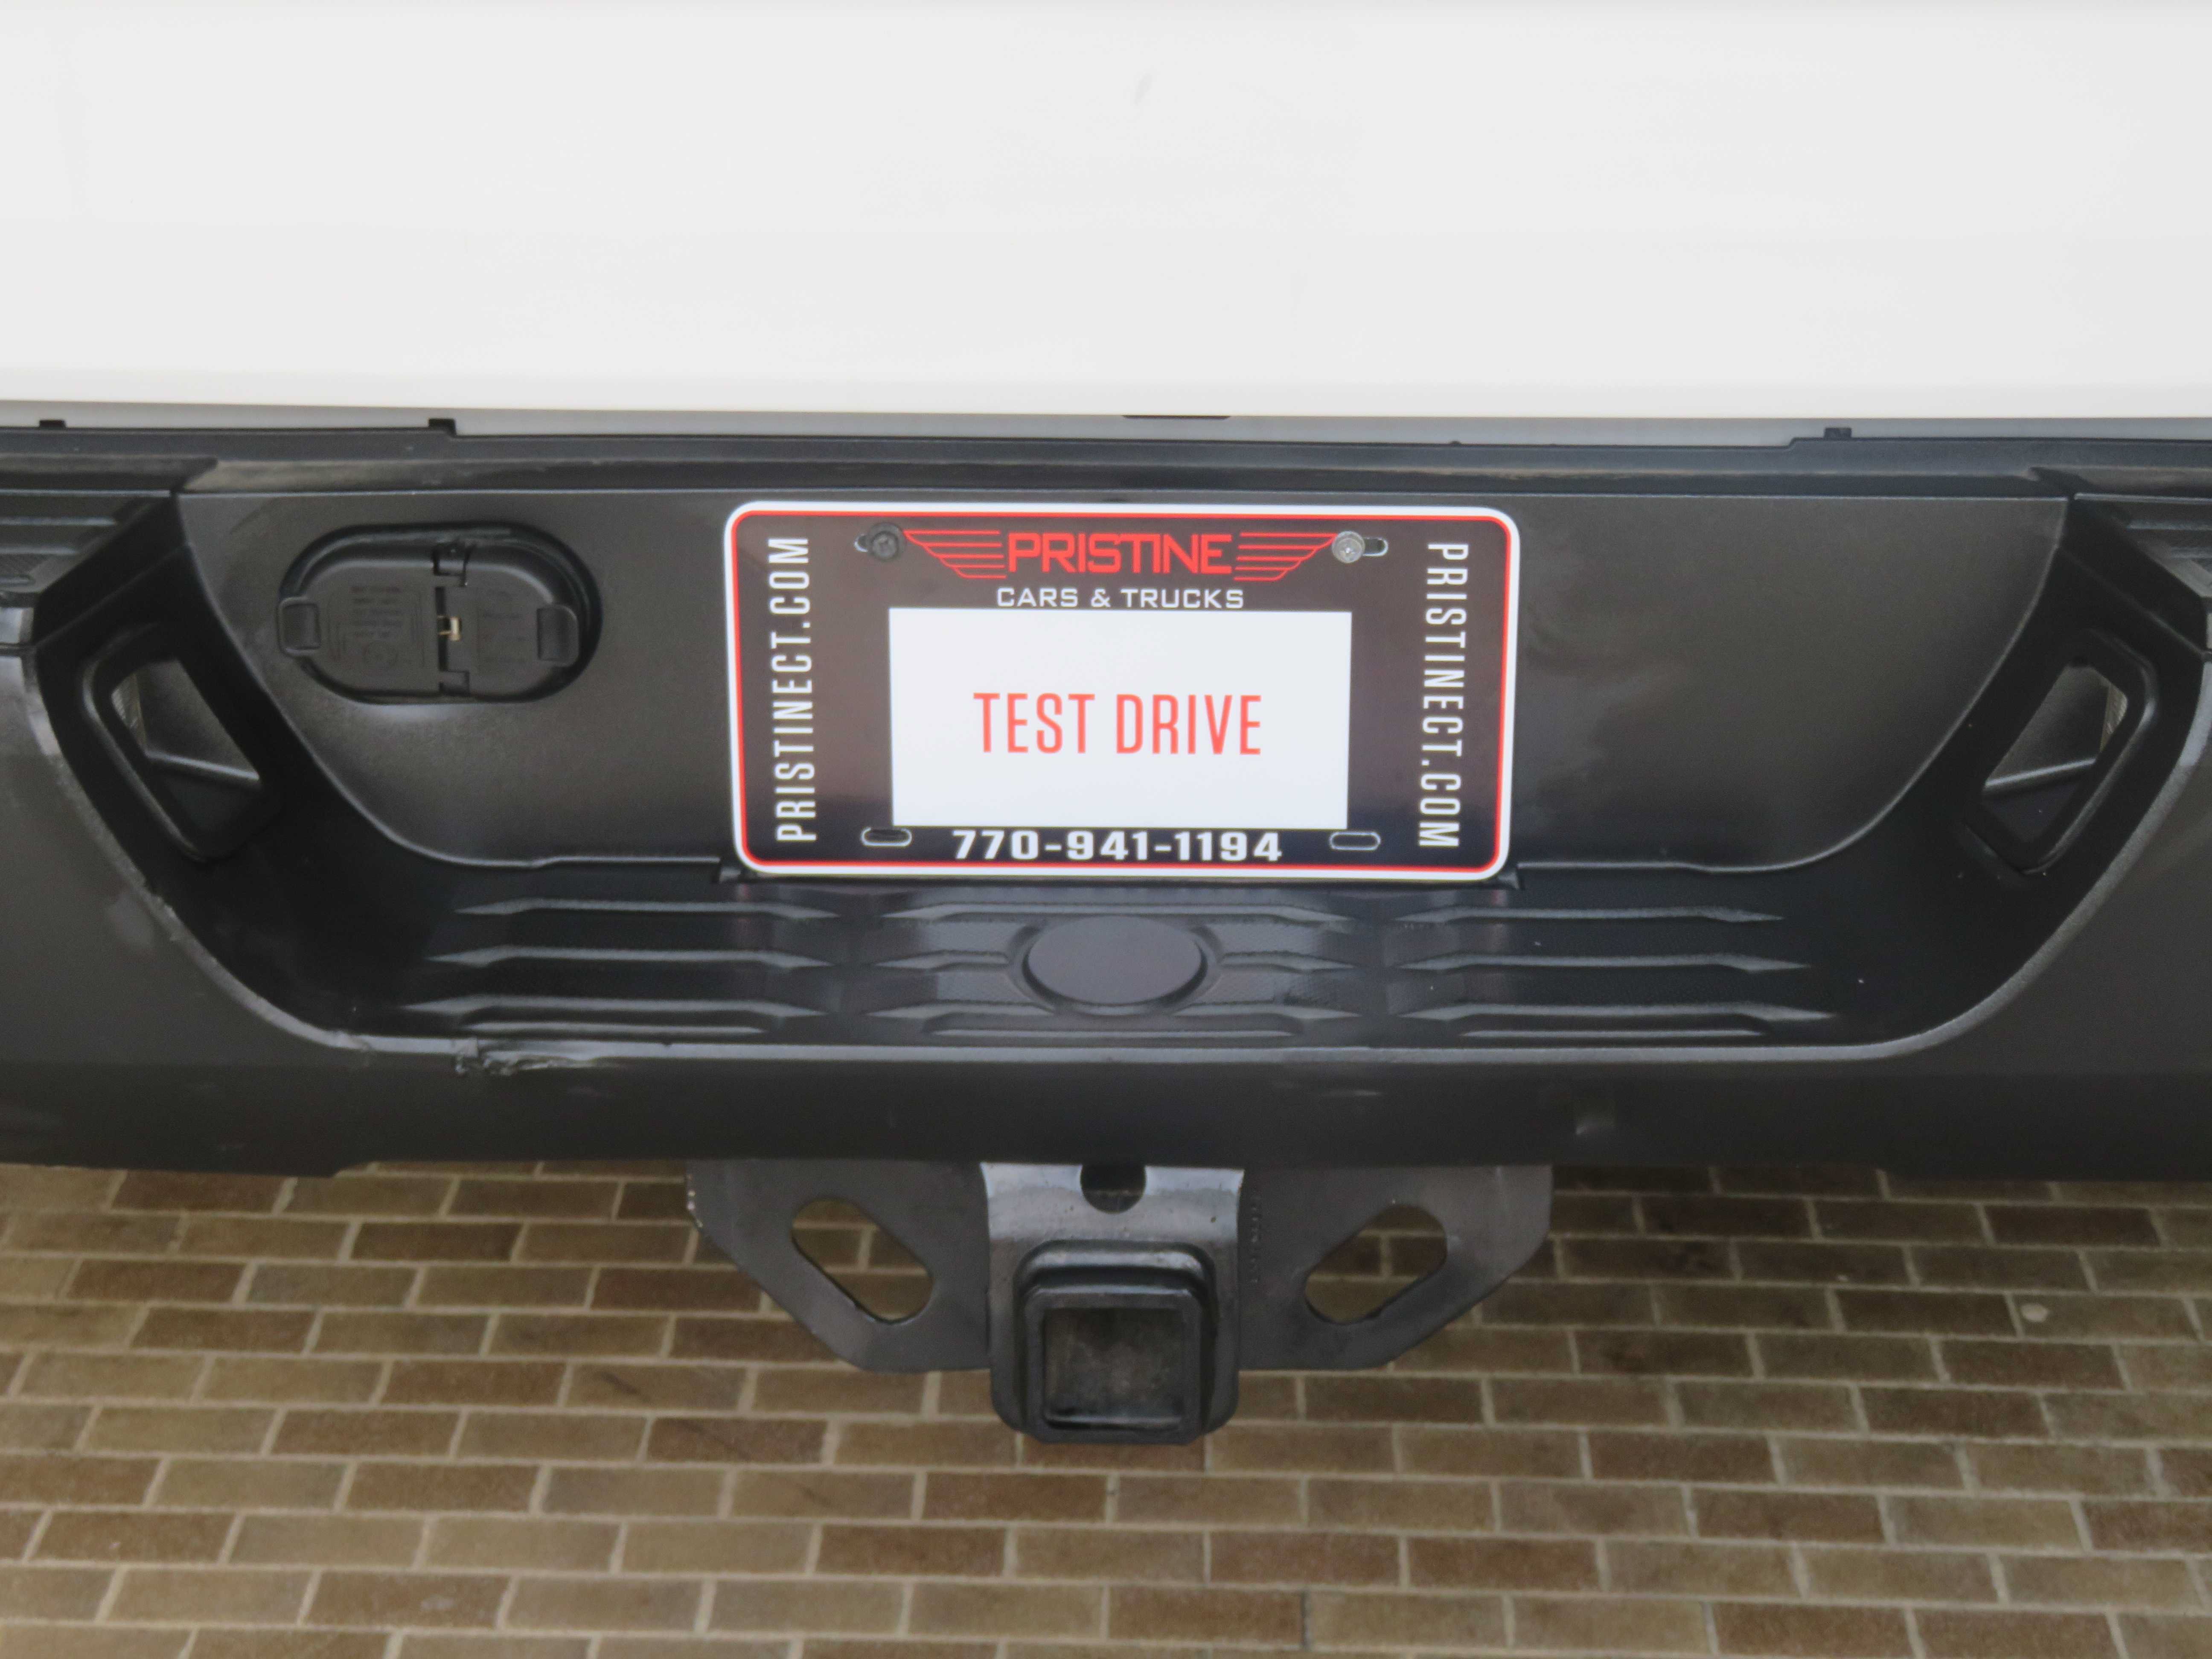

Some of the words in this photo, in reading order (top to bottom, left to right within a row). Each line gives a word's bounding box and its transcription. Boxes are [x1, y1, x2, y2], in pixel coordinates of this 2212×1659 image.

[1007, 533, 1232, 574] PRISTINE
[997, 587, 1079, 608] CARS
[1091, 587, 1112, 608] &
[1120, 587, 1244, 609] TRUCKS
[765, 536, 817, 844] PRISTINECT.COM
[1418, 542, 1469, 846] PRISTINECT.COM
[974, 693, 1095, 754] TEST
[1117, 694, 1261, 755] DRIVE
[952, 829, 1282, 861] 770-941-1194
